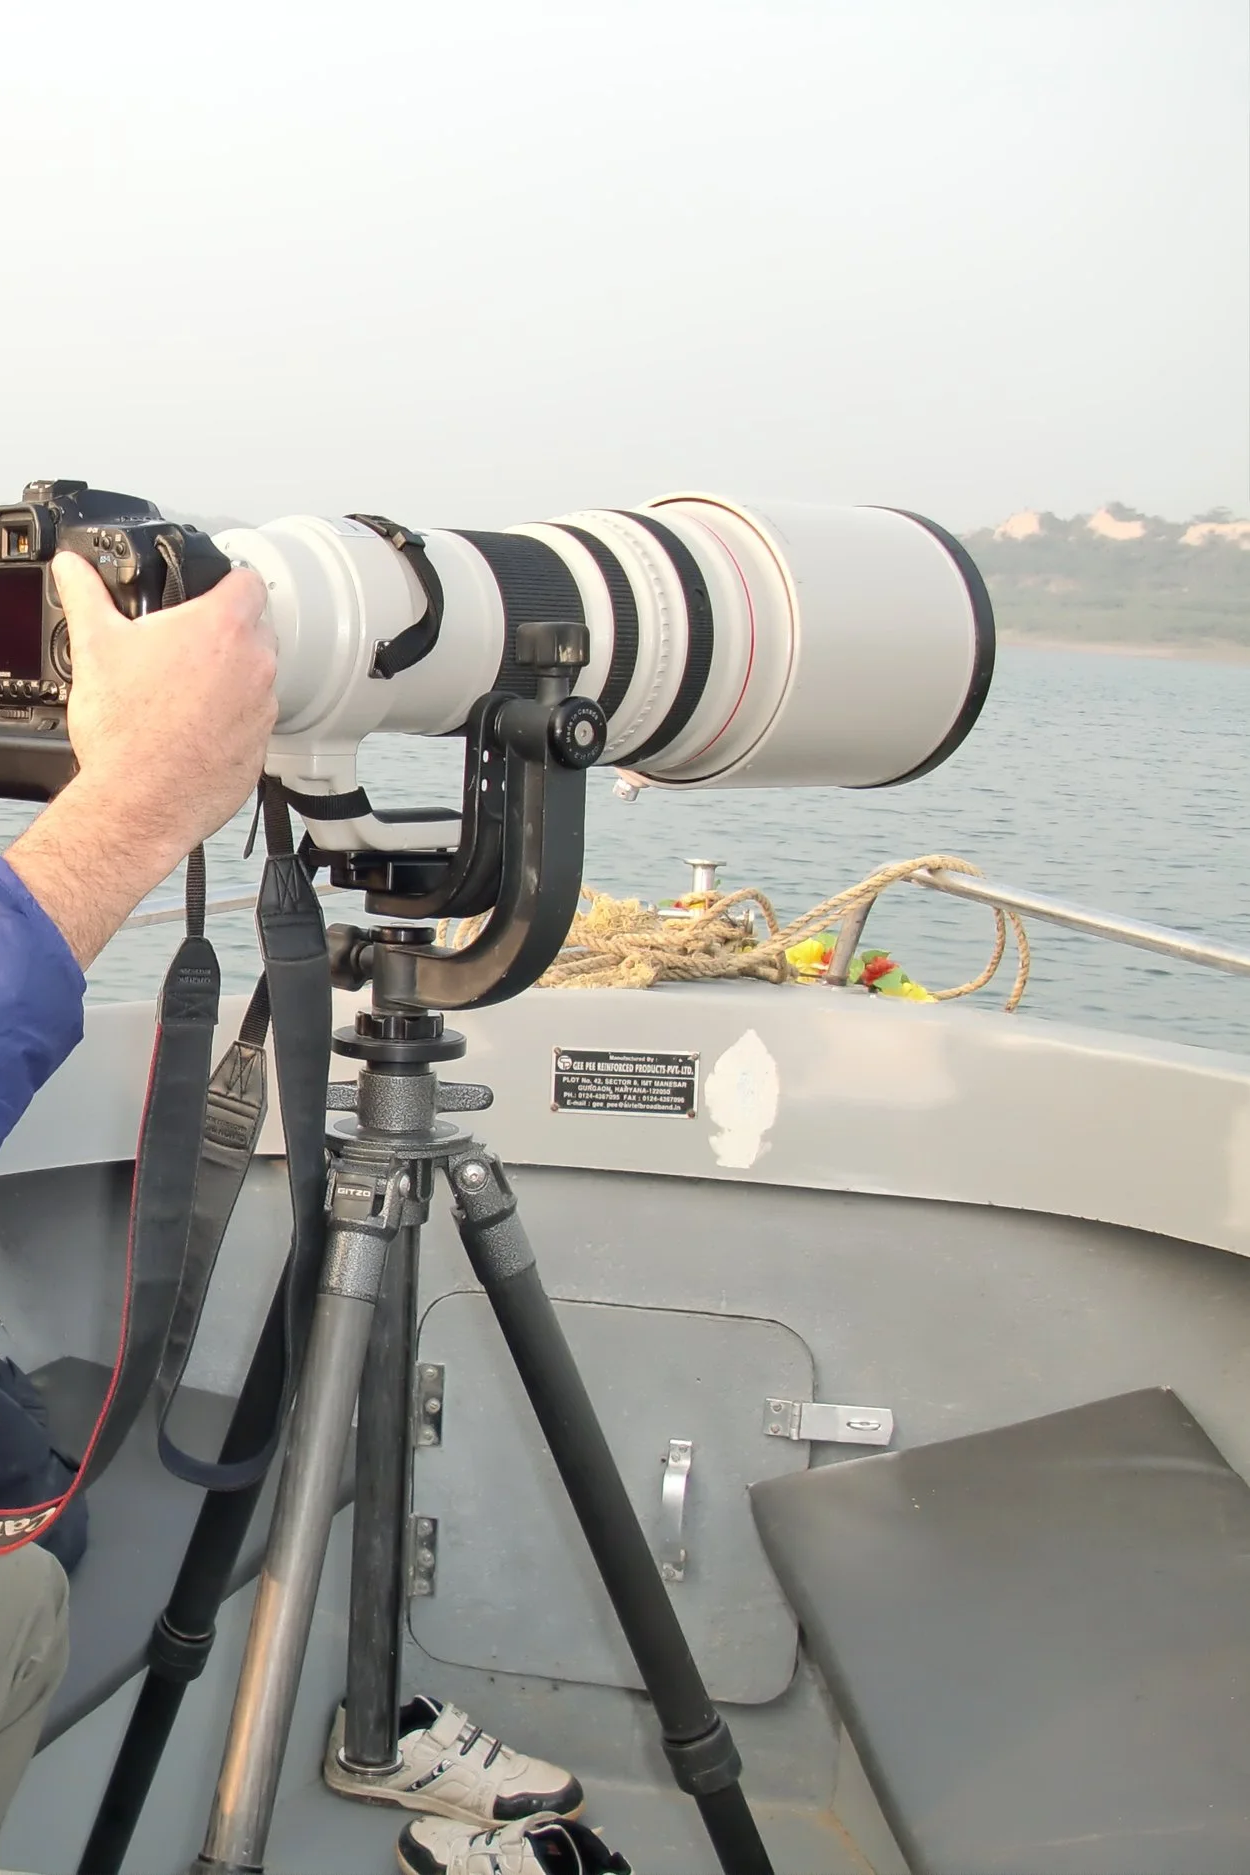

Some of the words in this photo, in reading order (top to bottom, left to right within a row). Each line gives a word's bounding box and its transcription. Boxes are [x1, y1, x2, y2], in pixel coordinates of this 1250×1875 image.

[578, 708, 599, 720] Canada
[573, 1061, 584, 1071] GEE
[585, 1062, 596, 1071] PEE
[597, 1062, 634, 1073] REINFORCED
[605, 1078, 632, 1086] SECTOR
[654, 1080, 687, 1088] MANESAR
[337, 1187, 371, 1197] GITZO
